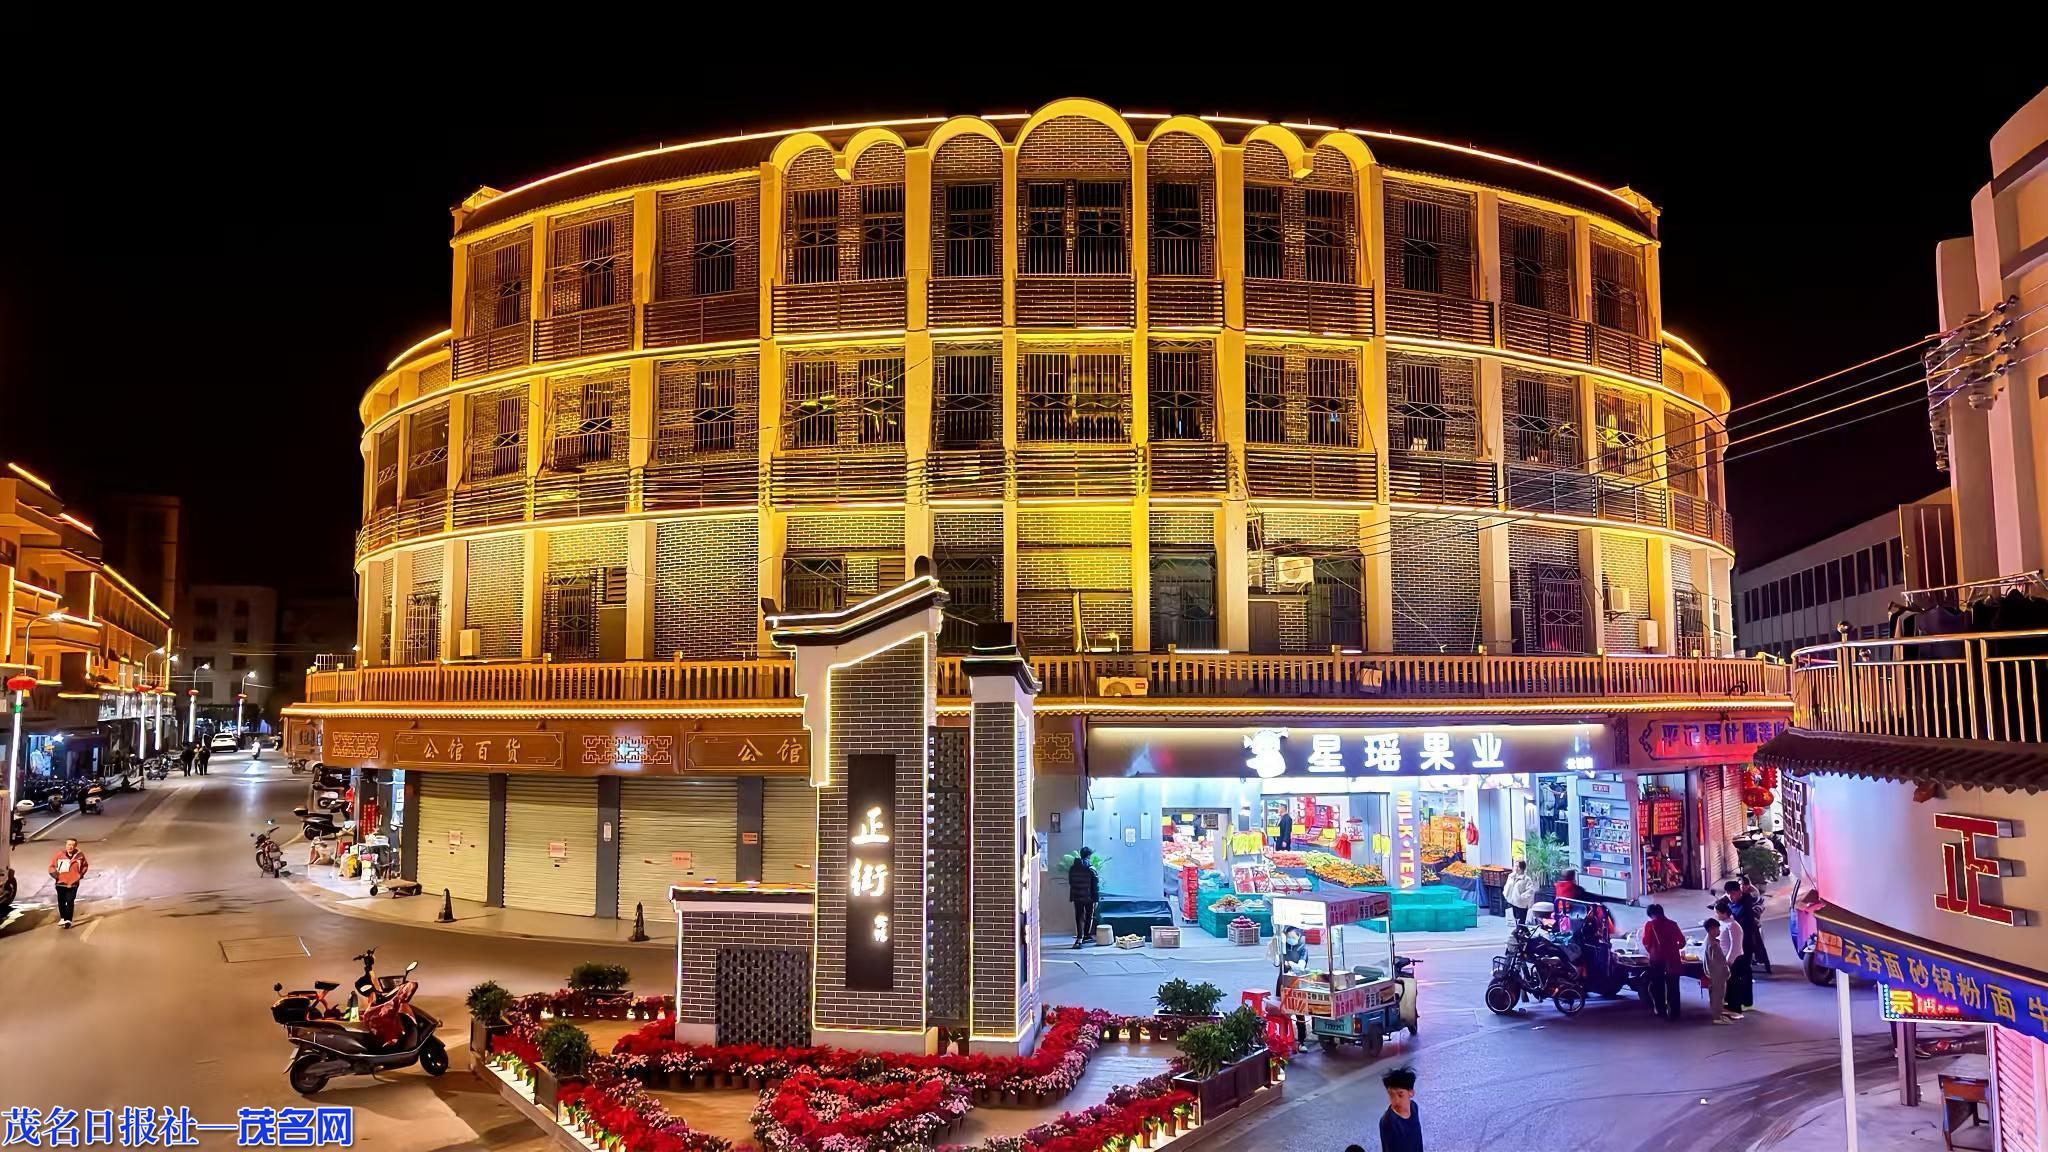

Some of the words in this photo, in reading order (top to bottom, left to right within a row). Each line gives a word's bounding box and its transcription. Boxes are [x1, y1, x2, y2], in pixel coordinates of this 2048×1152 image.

[423, 737, 522, 764] 公馆百货
[1307, 732, 1505, 773] 星瑶果业
[1934, 813, 2013, 926] 正
